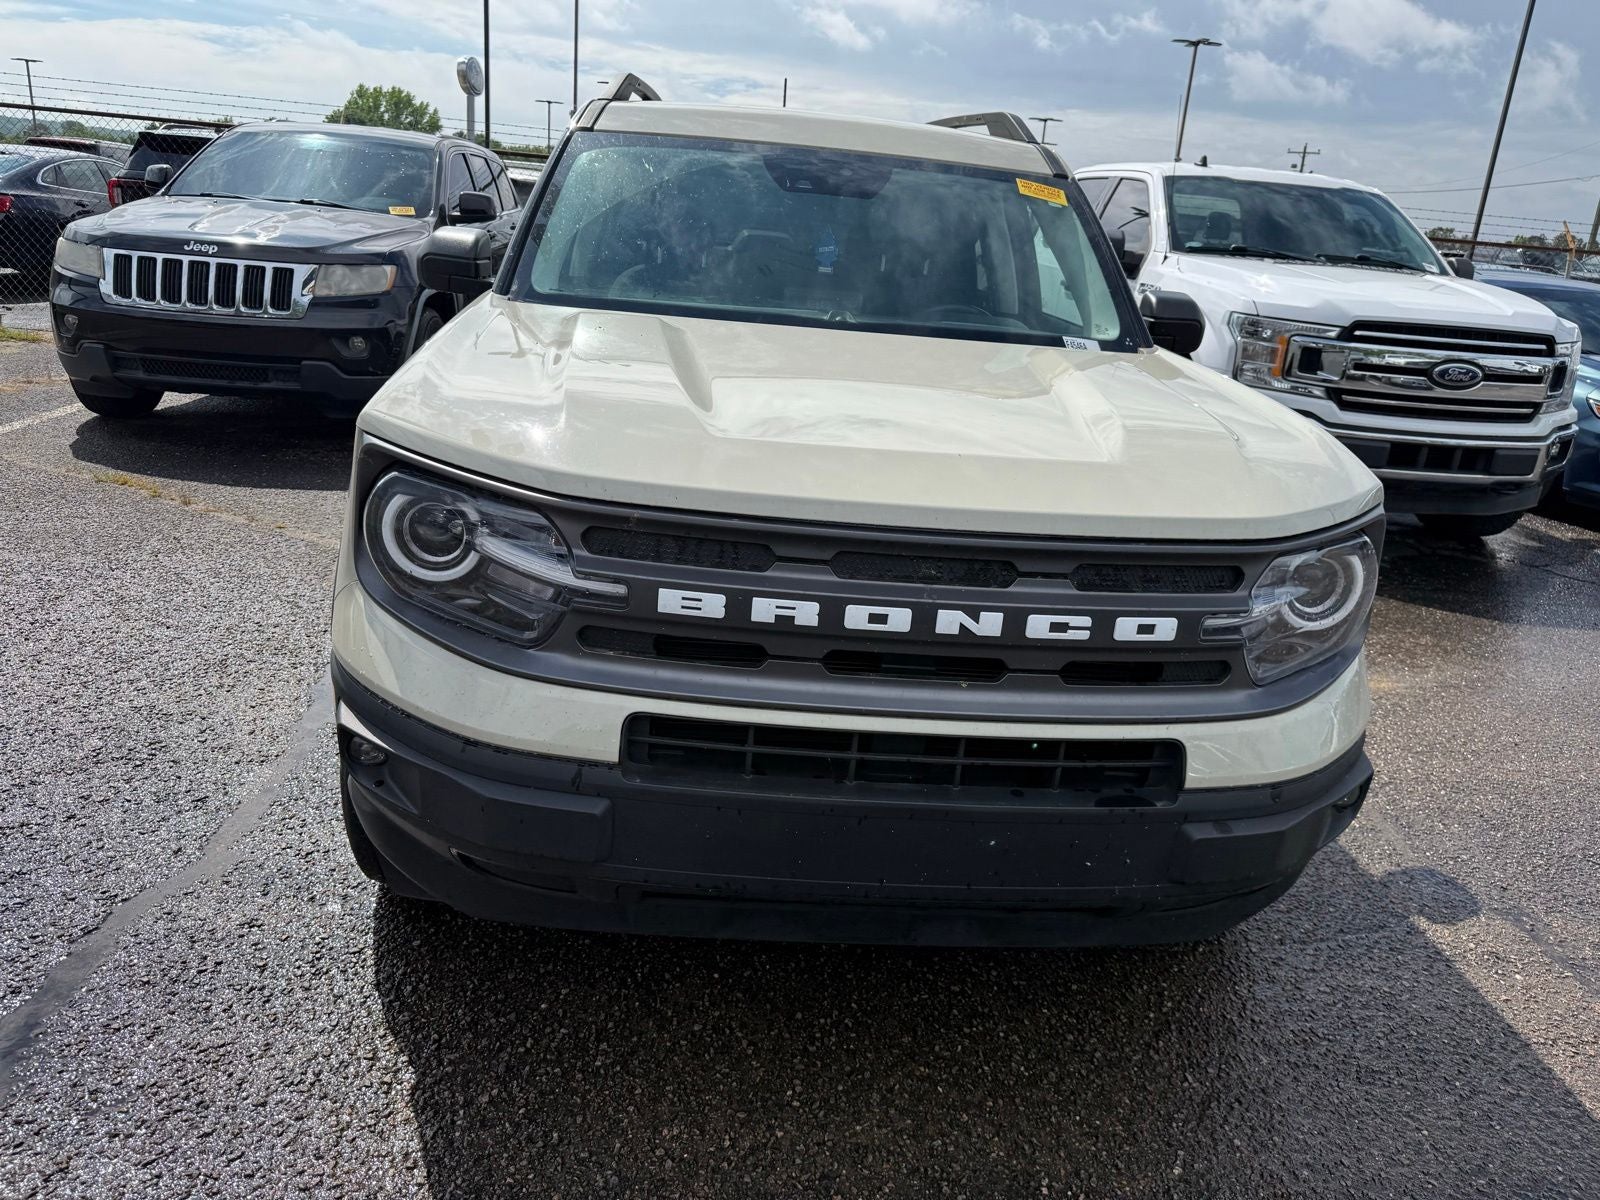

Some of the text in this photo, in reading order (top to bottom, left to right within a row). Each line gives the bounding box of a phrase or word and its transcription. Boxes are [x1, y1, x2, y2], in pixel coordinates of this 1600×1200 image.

[1034, 183, 1060, 194] VEHICLE
[183, 240, 217, 253] Jeep
[1444, 367, 1472, 382] Ford
[657, 588, 1178, 641] BRONCO
